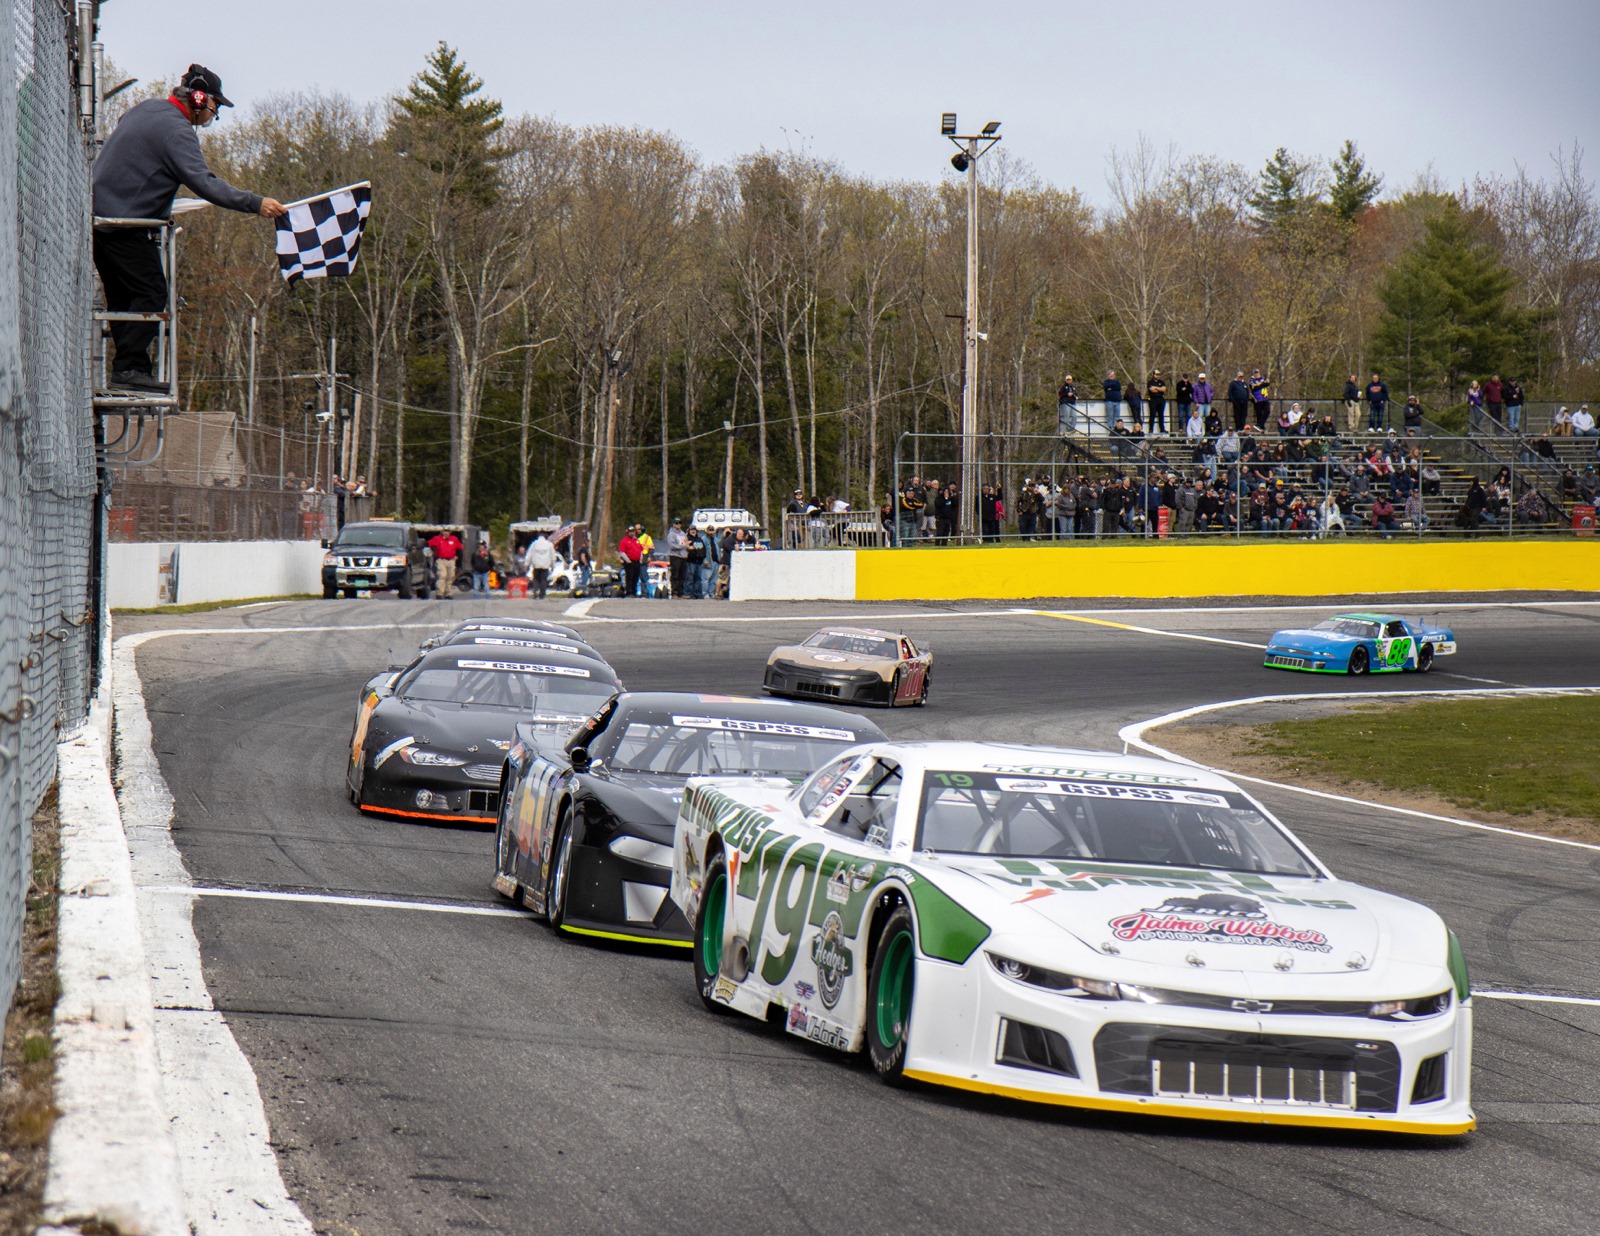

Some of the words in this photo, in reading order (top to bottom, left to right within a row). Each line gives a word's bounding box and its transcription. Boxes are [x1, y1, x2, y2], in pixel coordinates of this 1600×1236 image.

[1386, 638, 1412, 667] 88
[491, 661, 558, 673] GSPSS
[720, 720, 810, 735] GSPSS
[934, 773, 974, 787] 19
[983, 764, 1197, 786] KRUZCEK
[1060, 783, 1174, 801] GSPSS
[749, 834, 825, 986] 19
[1108, 912, 1210, 941] Jaime
[1211, 918, 1329, 946] Webber
[1139, 930, 1334, 954] PHOTOGRAPHY
[813, 935, 850, 982] Hedges
